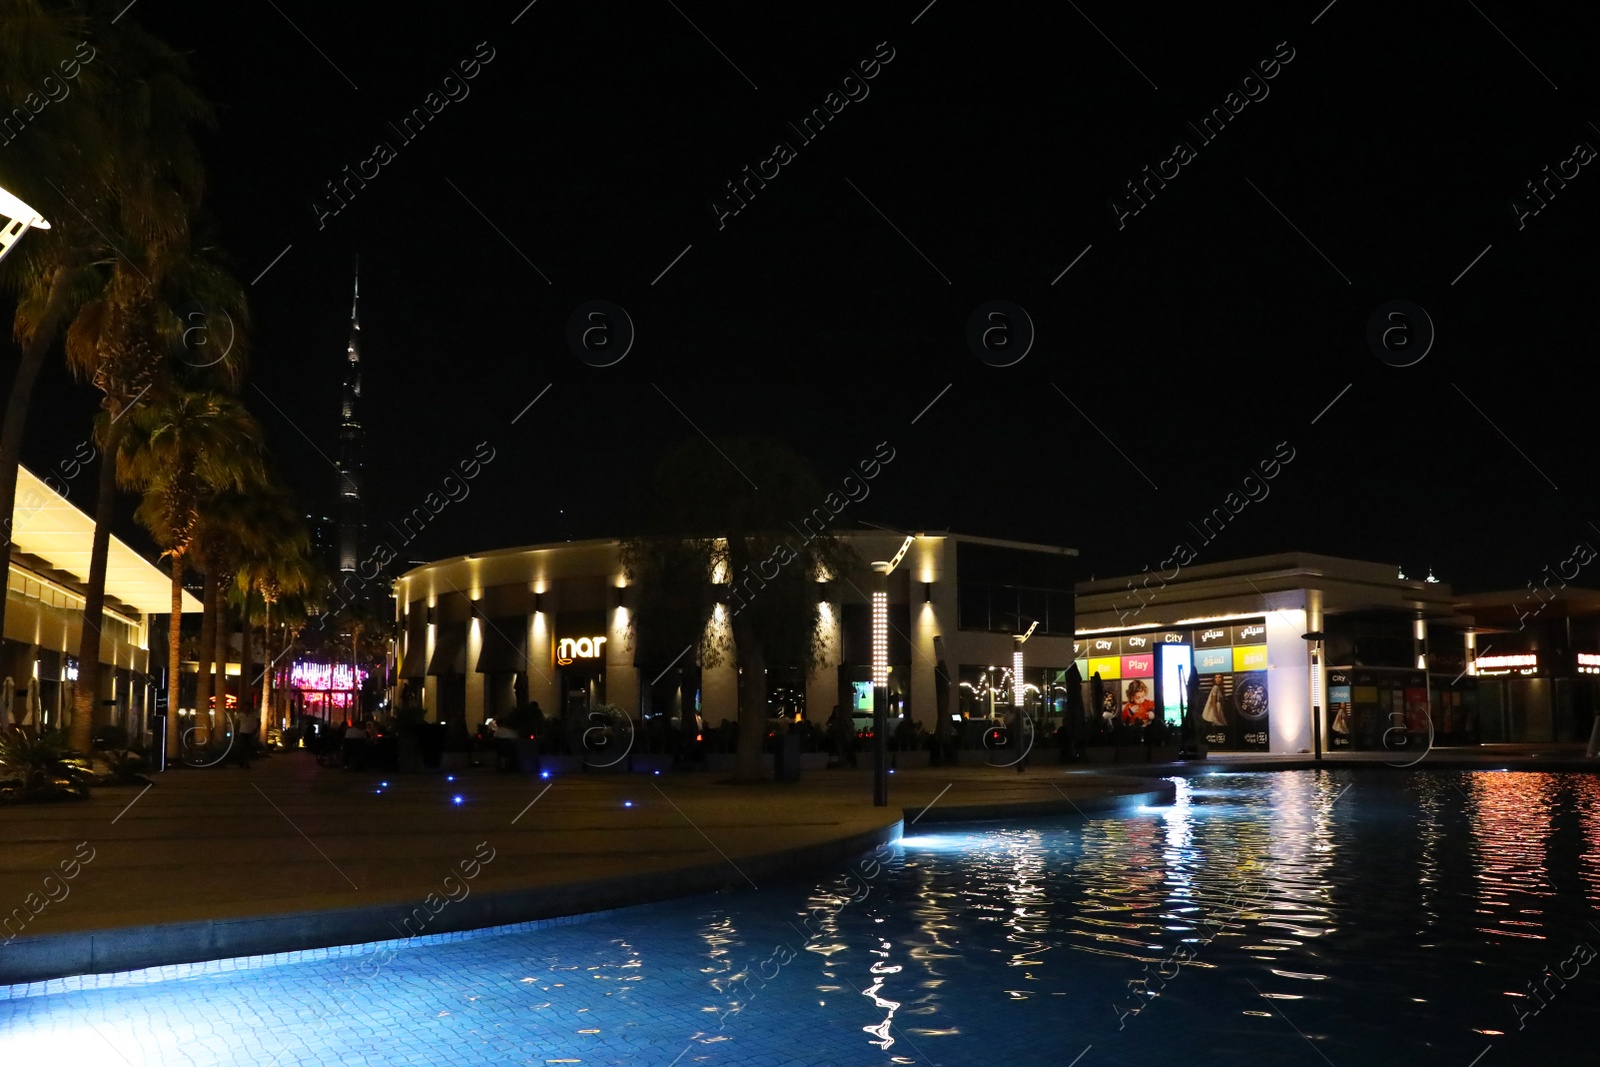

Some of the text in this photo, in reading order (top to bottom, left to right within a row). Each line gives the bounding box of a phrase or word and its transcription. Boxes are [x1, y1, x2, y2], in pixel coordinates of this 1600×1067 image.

[1129, 637, 1146, 647] City
[1165, 634, 1183, 643] City
[559, 636, 608, 660] nar
[1095, 640, 1112, 650] City
[1128, 660, 1148, 671] Play
[1332, 674, 1346, 683] City
[1330, 691, 1349, 700] Shop
